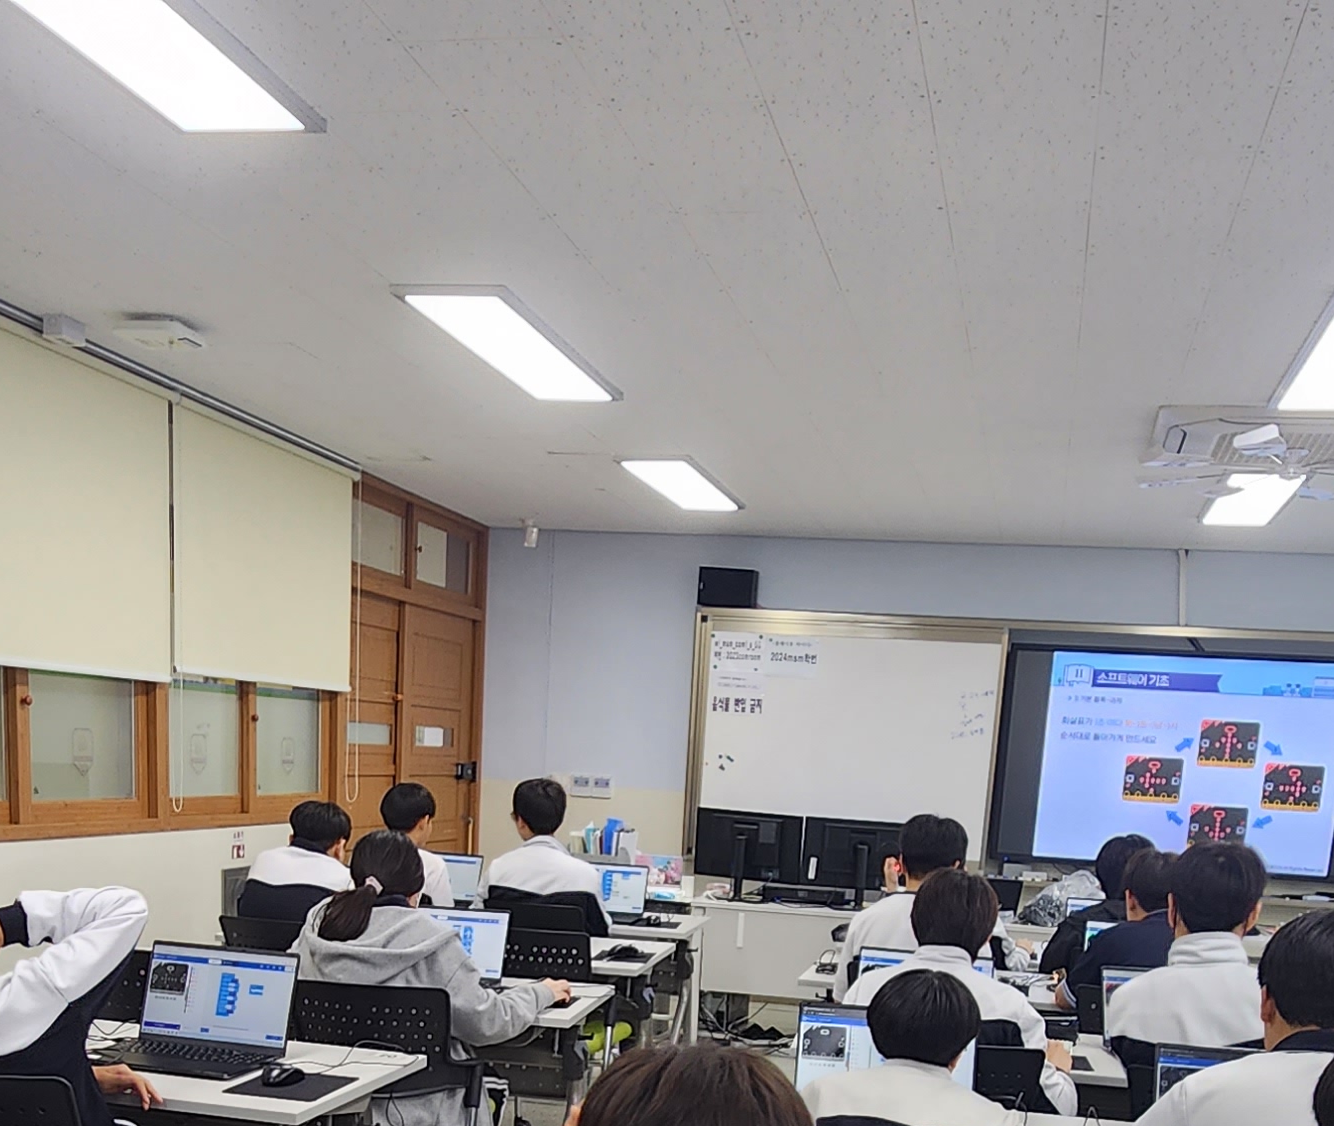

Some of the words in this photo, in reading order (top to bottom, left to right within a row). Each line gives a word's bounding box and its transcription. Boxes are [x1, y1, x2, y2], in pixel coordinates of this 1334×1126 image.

[1097, 672, 1148, 687] 소프트웨어
[1149, 674, 1170, 687] 기초
[712, 696, 731, 713] 음식물
[734, 698, 747, 713] 반입
[750, 698, 763, 714] 금지
[1061, 716, 1093, 726] 화살표가
[1060, 731, 1091, 741] 순서대로
[1093, 733, 1124, 743] 돌아가게
[1125, 734, 1157, 744] 만드세요
